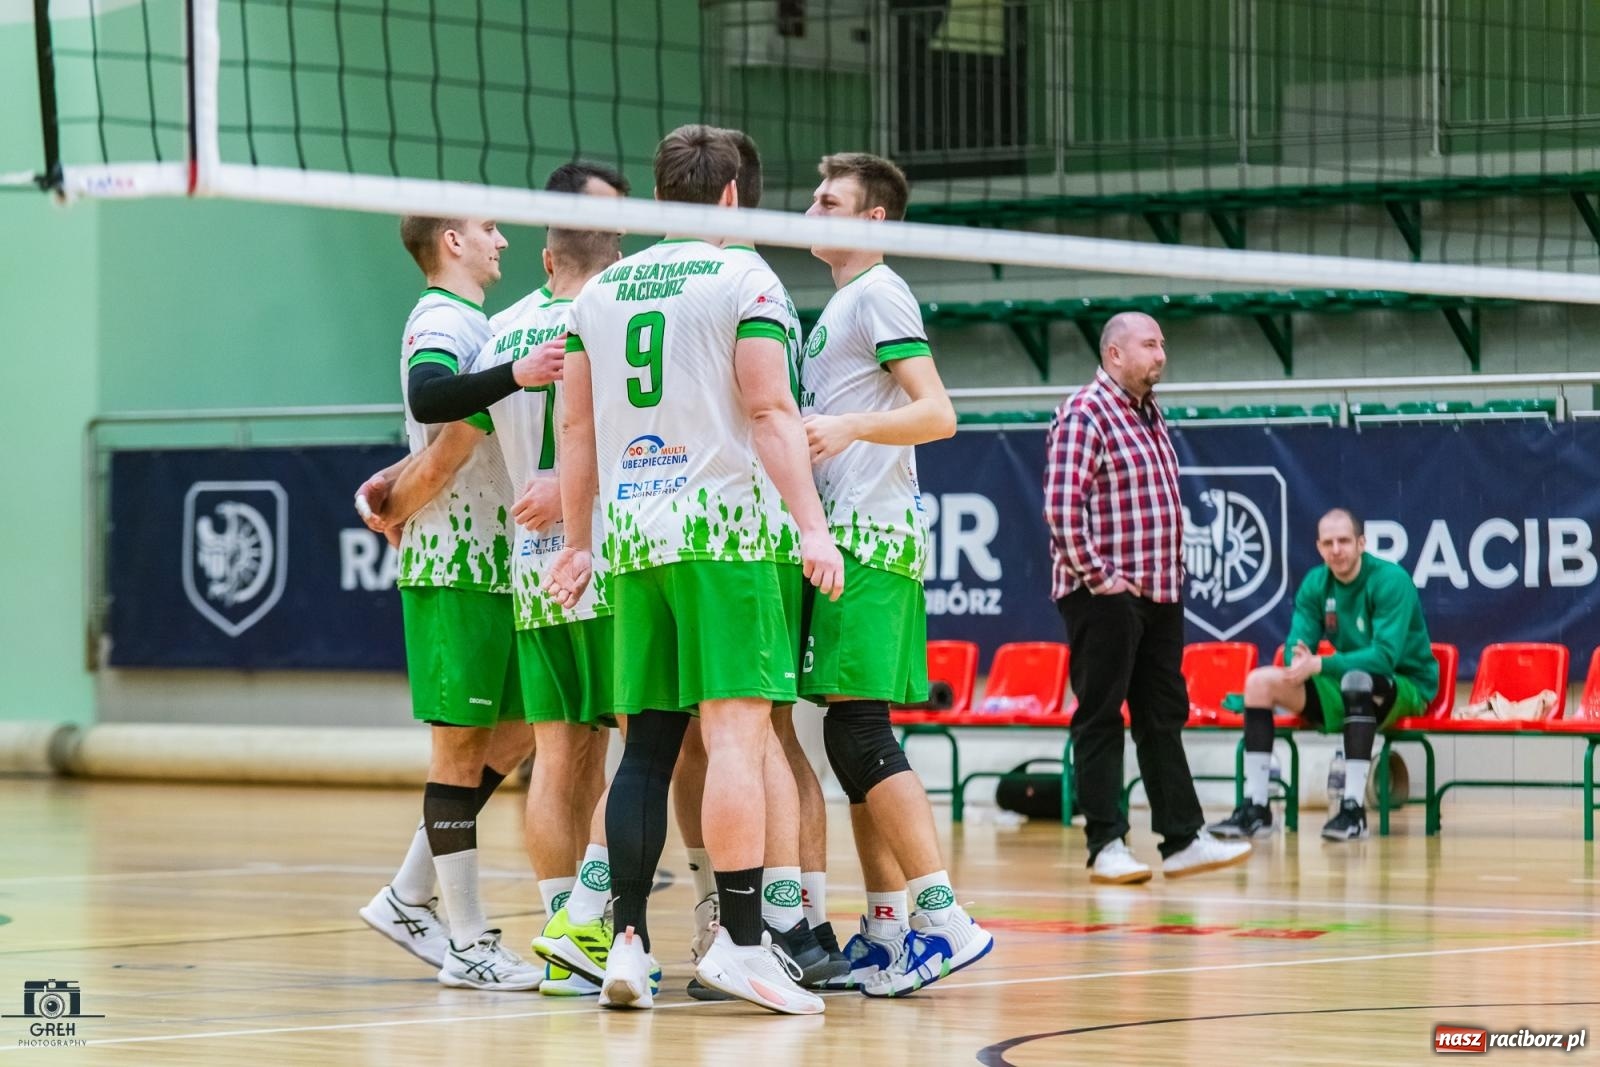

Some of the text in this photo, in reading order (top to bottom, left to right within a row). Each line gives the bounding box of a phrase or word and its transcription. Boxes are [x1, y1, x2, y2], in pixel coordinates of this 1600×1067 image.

[626, 311, 666, 408] 9
[524, 382, 556, 470] 7
[661, 446, 686, 455] MULTI
[622, 455, 688, 469] UBEZPIECZENIA
